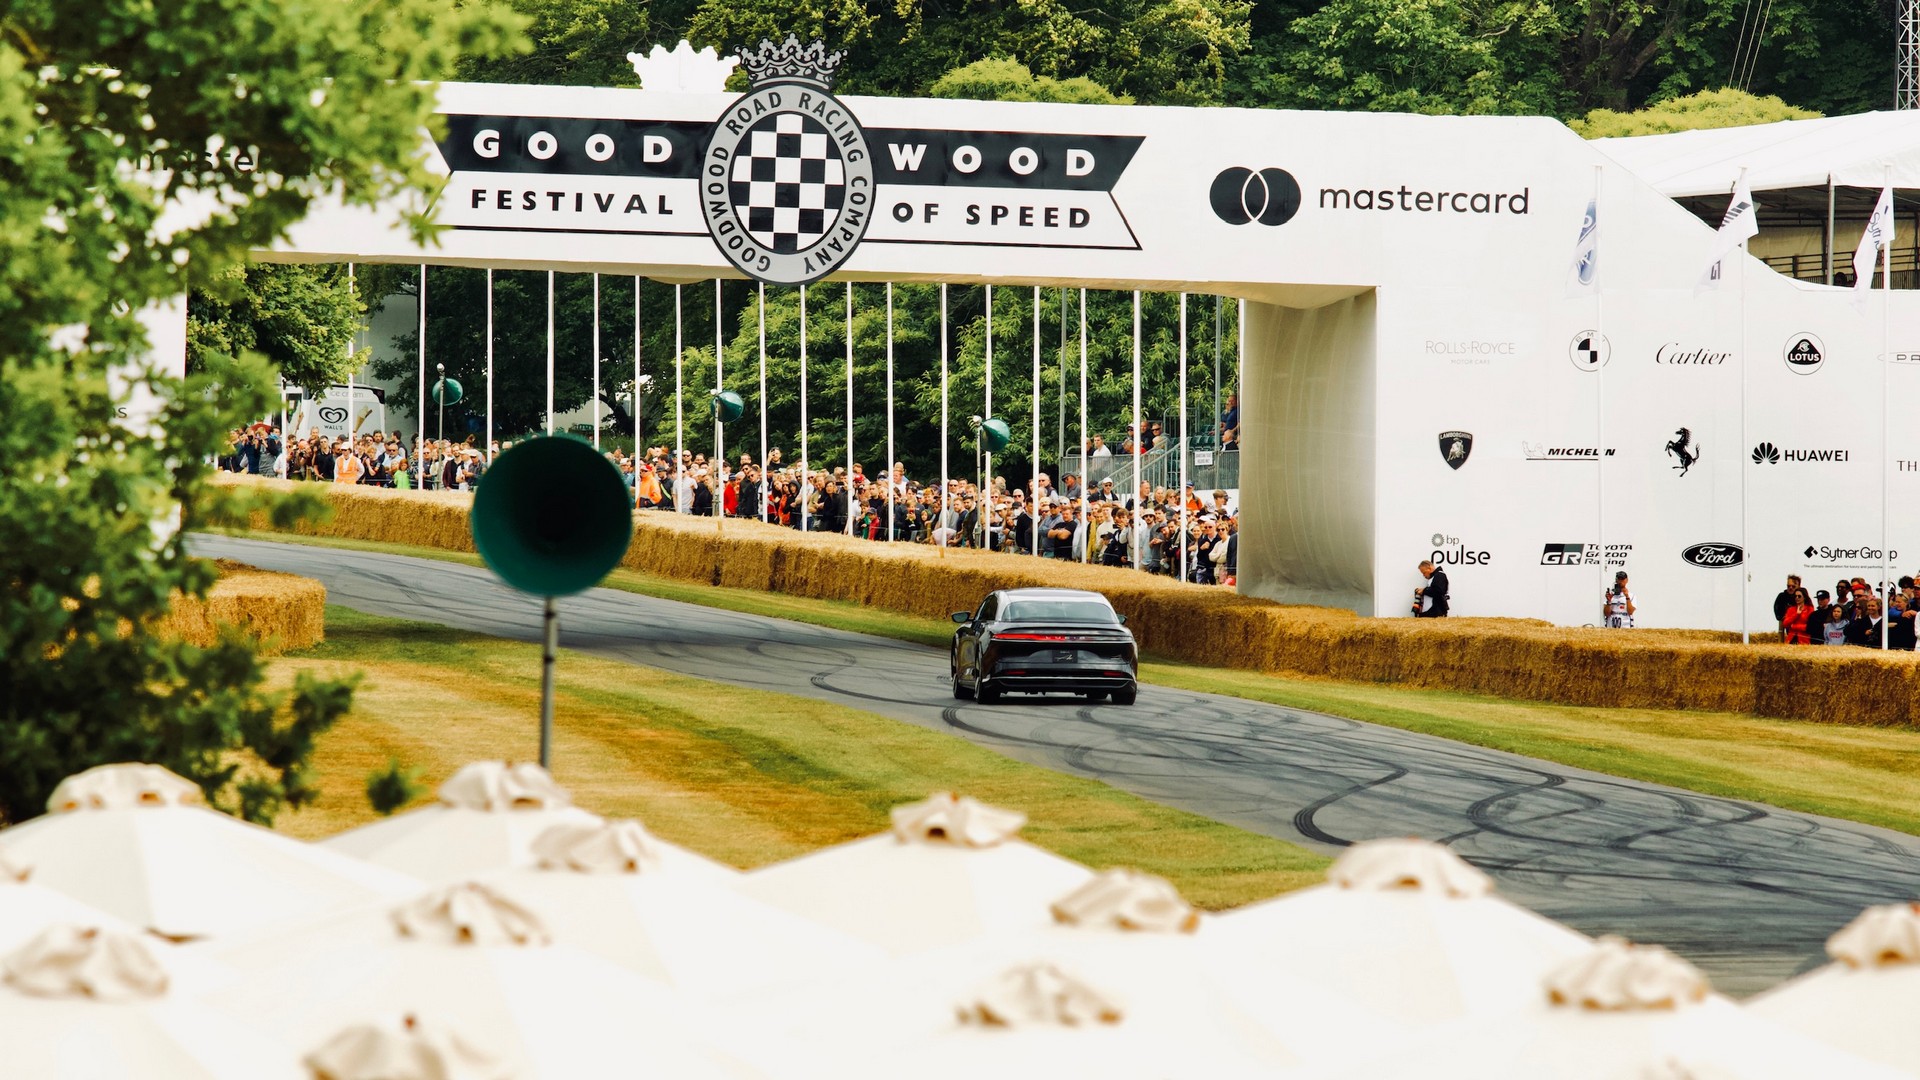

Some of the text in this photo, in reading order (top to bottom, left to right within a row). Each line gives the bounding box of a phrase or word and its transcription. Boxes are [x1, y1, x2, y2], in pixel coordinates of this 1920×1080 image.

[472, 129, 1096, 177] GOOD WOOD
[707, 91, 868, 274] GOODWOOD ROAD RACING COMPANY
[1319, 185, 1529, 215] mastercard
[471, 188, 1090, 228] FESTIVAL OF SPEED
[1425, 340, 1516, 355] ROLLS-ROYCE
[1656, 342, 1732, 365] Cartier
[1789, 352, 1820, 362] LOTUS
[1547, 448, 1616, 456] MICHELN
[1784, 449, 1849, 462] HUAWEI
[1446, 535, 1460, 546] bp
[1542, 551, 1581, 565] GR
[1695, 546, 1737, 564] Ford
[1820, 546, 1898, 562] Sytner Grop
[1584, 558, 1626, 567] Raing
